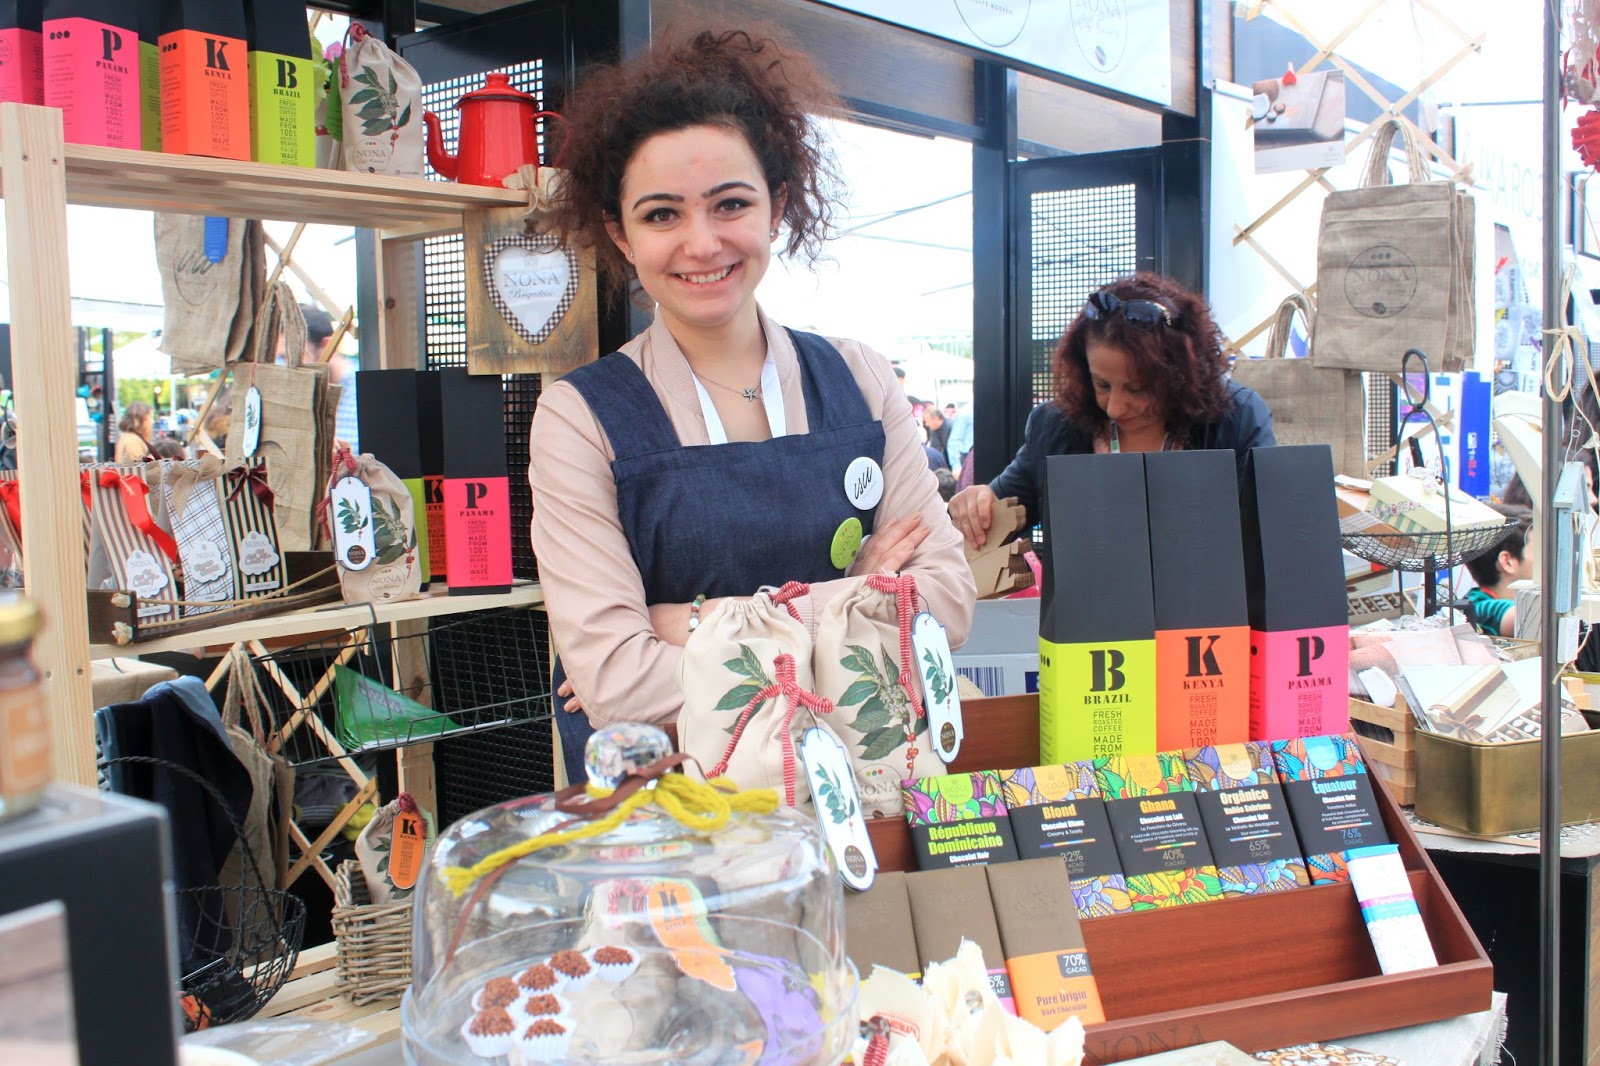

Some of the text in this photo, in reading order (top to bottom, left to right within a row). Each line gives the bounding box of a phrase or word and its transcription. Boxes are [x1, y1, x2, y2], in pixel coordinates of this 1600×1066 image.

[101, 28, 123, 61] P
[204, 37, 230, 71] K
[96, 60, 128, 74] PANAMA
[204, 69, 231, 80] KENYA
[276, 59, 298, 89] B
[273, 88, 301, 98] BRAZIL
[281, 152, 298, 160] WAVE
[356, 149, 386, 158] NONA
[503, 272, 560, 287] NONA
[424, 479, 445, 504] K
[465, 483, 488, 509] P
[371, 574, 402, 586] NONA
[1185, 635, 1223, 677] K
[1296, 636, 1325, 677] P
[1089, 649, 1126, 692] B
[1183, 679, 1224, 690] KENYA
[1288, 677, 1332, 690] PANAMA
[1084, 693, 1132, 705] BRAZIL
[1190, 694, 1217, 703] FRESH
[1299, 693, 1322, 702] FRESH
[1093, 710, 1122, 718] FRESH
[1189, 708, 1217, 717] COFFEE
[1299, 707, 1322, 716] COFFEE
[1190, 719, 1217, 728] MADE
[1299, 716, 1322, 725] MADE
[1093, 724, 1122, 732] COFFEE
[1190, 728, 1217, 737] FROM
[1299, 725, 1322, 734] FROM
[1093, 735, 1122, 743] MADE
[1093, 743, 1122, 753] FROM
[1312, 780, 1357, 795] Équateur
[1220, 789, 1269, 805] Orgânico
[1042, 804, 1077, 820] Blond
[1140, 800, 1176, 814] Ghana
[1139, 815, 1165, 825] Chocolat
[1232, 815, 1258, 824] Chocolat
[402, 818, 417, 835] K
[928, 821, 997, 841] République
[1041, 821, 1068, 831] Chocolat
[1047, 830, 1065, 838] Creamy
[1340, 828, 1361, 839] 76%
[928, 835, 1003, 855] Dominicaine
[1249, 840, 1270, 851] 65%
[949, 852, 978, 863] Chocolat
[1060, 850, 1084, 863] 32%
[1163, 848, 1184, 861] 40%
[1251, 850, 1271, 858] CACAO
[1066, 861, 1084, 869] ACAO
[1063, 954, 1086, 967] 70%
[1066, 966, 1087, 974] CACAO
[1036, 990, 1087, 1006] Pure Origin
[1041, 1004, 1088, 1017] Dark Chocolate
